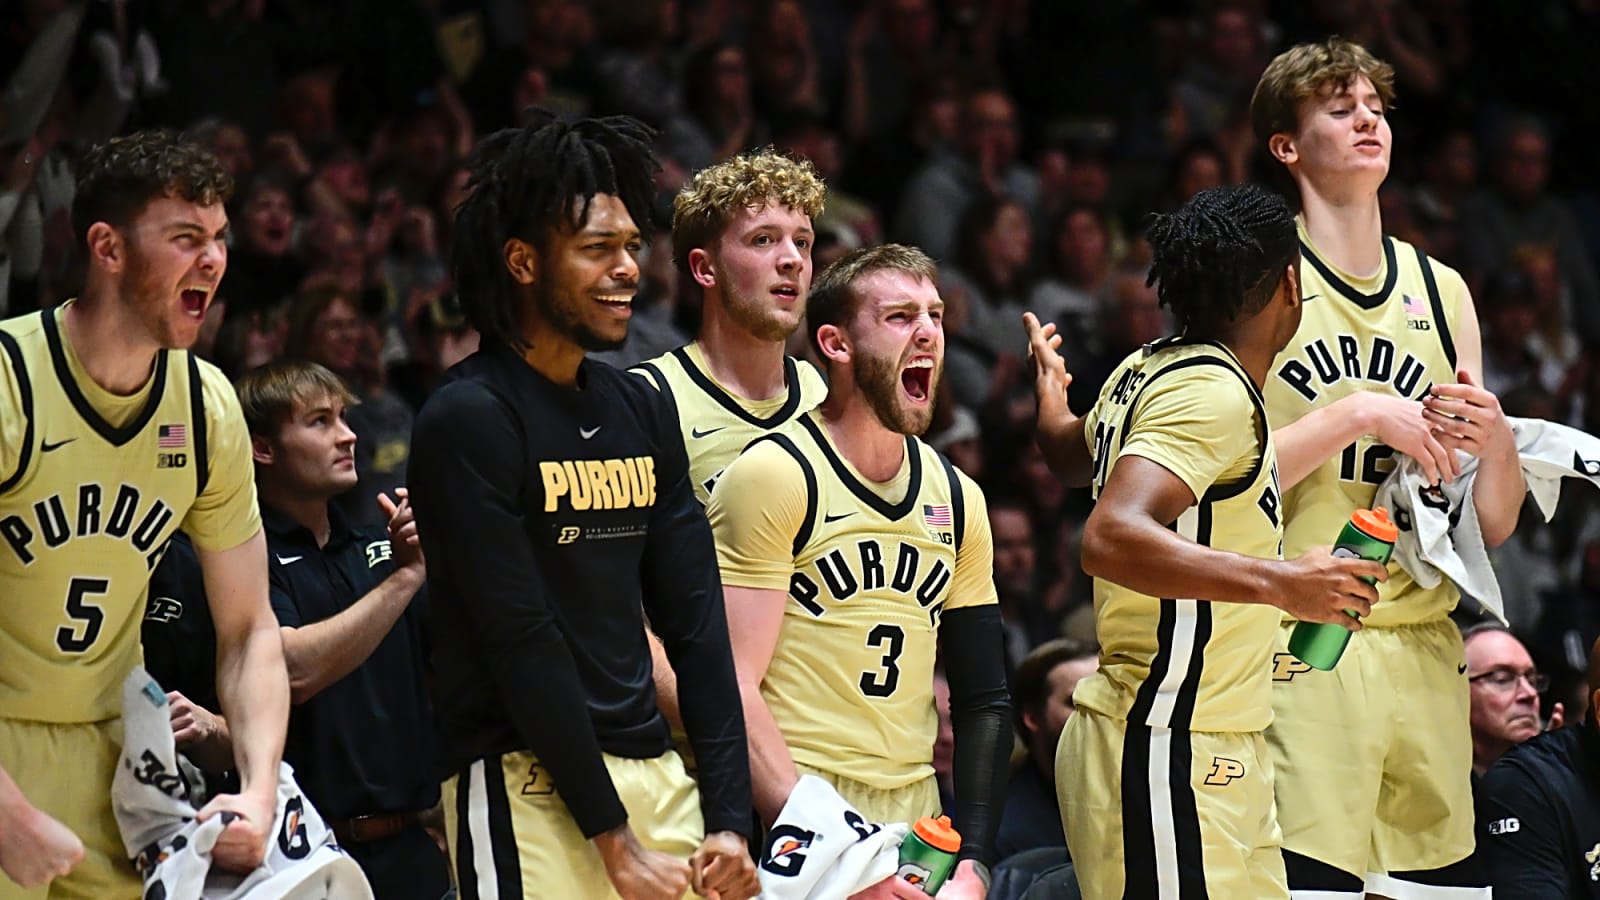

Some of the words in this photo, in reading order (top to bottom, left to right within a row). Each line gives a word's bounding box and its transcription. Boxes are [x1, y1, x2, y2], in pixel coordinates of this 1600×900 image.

[556, 525, 581, 544] P
[57, 578, 109, 652] 5
[860, 624, 905, 697] 3
[1204, 757, 1245, 785] P
[761, 824, 815, 877] G
